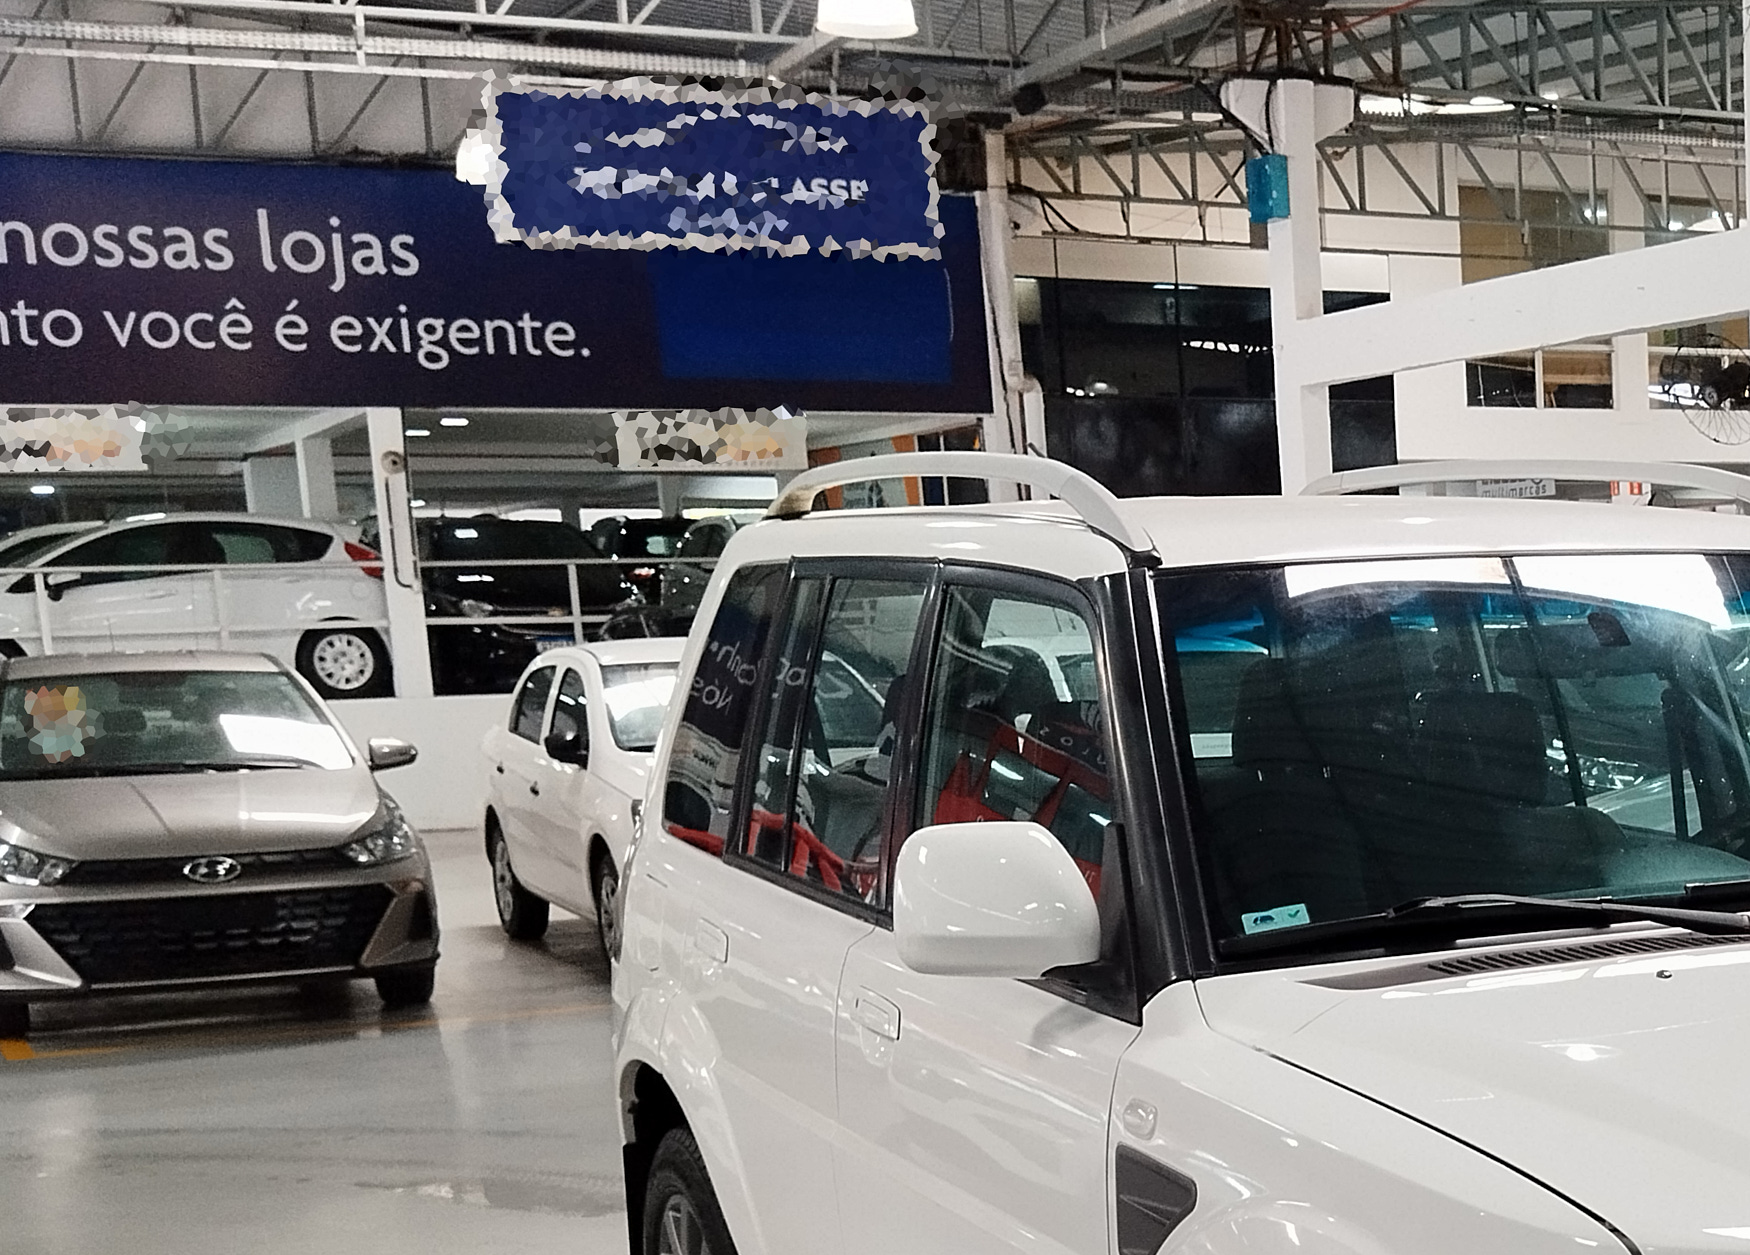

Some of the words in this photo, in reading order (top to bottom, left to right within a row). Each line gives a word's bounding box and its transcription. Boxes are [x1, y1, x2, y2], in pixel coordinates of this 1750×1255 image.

[0, 219, 235, 272] nossas
[256, 207, 420, 293] lojas
[0, 299, 84, 348] to
[102, 296, 254, 351] você
[274, 298, 309, 352] é
[329, 303, 591, 371] exigente.
